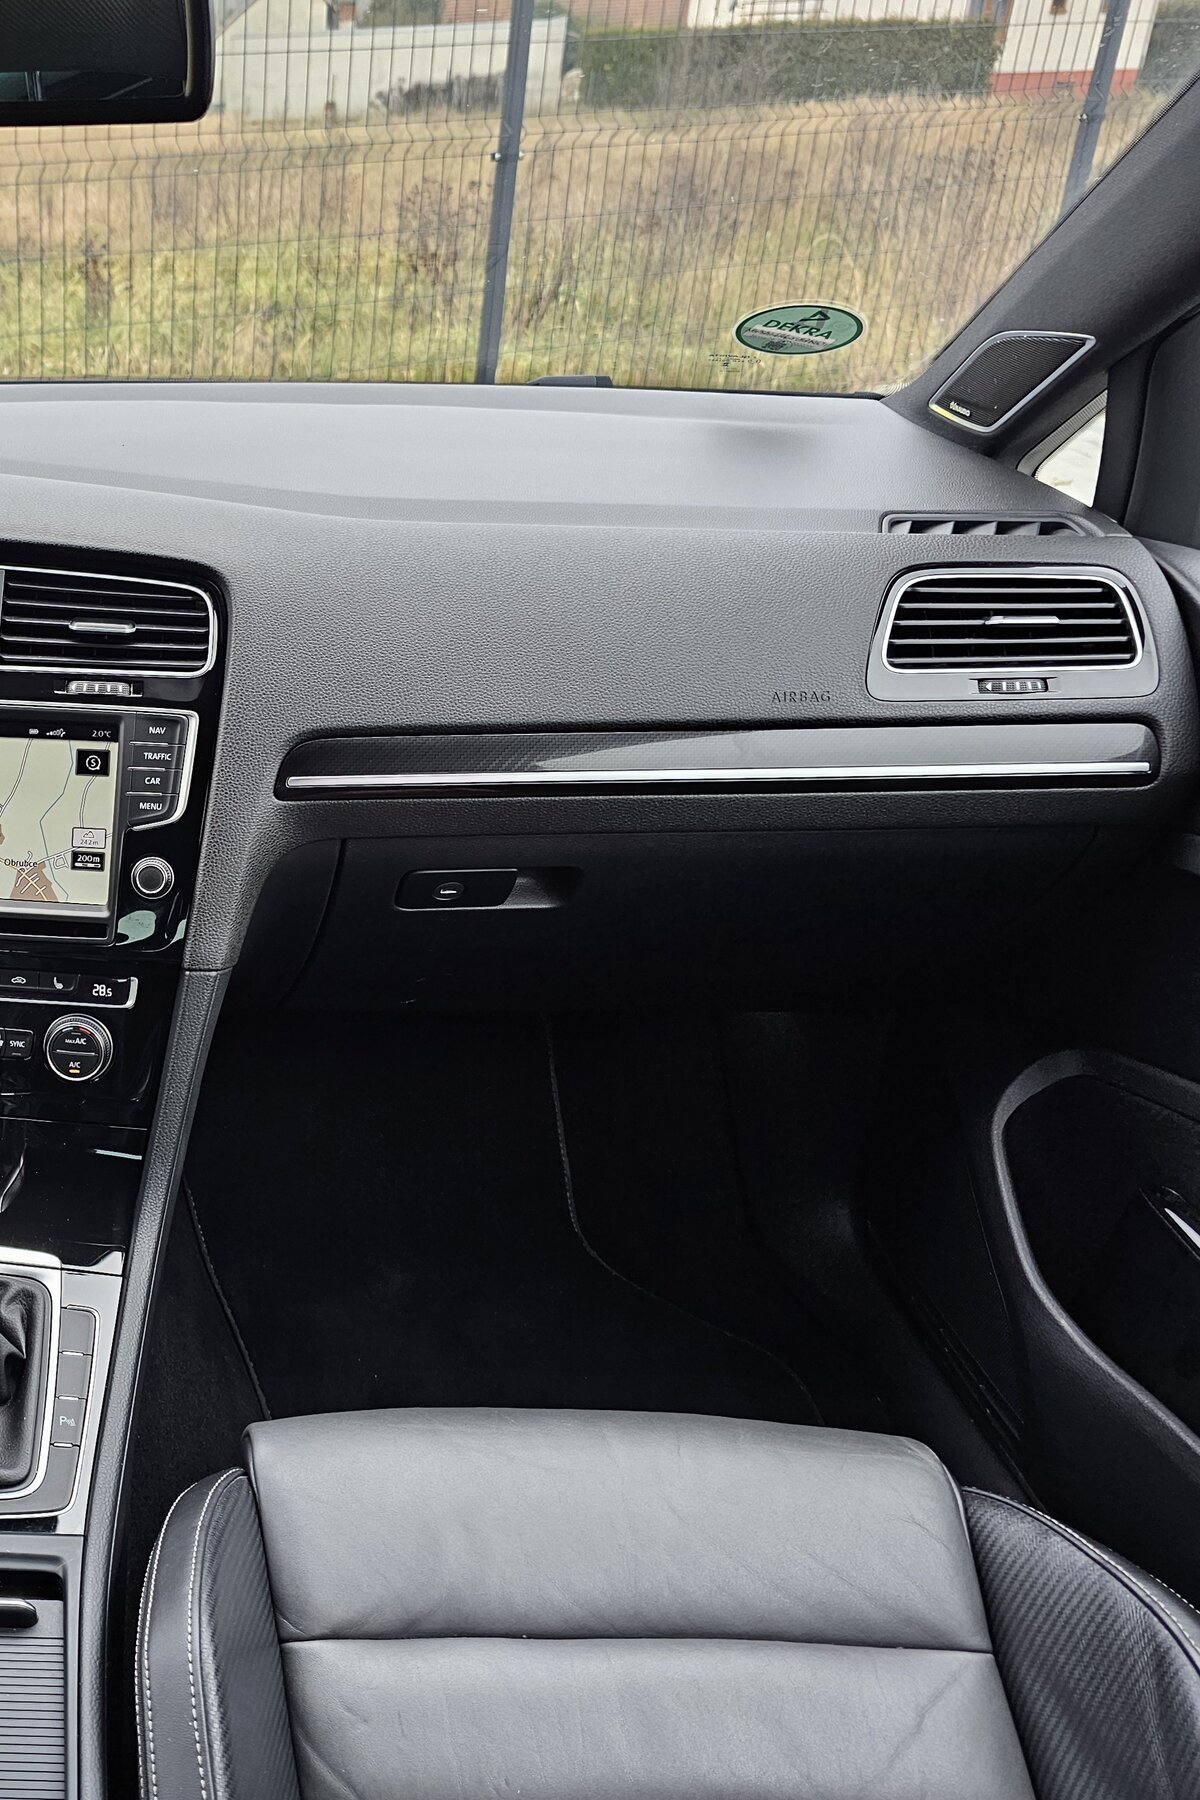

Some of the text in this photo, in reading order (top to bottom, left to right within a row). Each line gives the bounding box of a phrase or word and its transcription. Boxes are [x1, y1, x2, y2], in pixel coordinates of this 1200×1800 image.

[762, 318, 833, 341] DEKRA
[771, 691, 831, 703] AIRBAG
[149, 726, 166, 734] NAV
[144, 752, 172, 760] TRAFFIC
[139, 802, 162, 810] MENU
[4, 858, 38, 868] Obrubce
